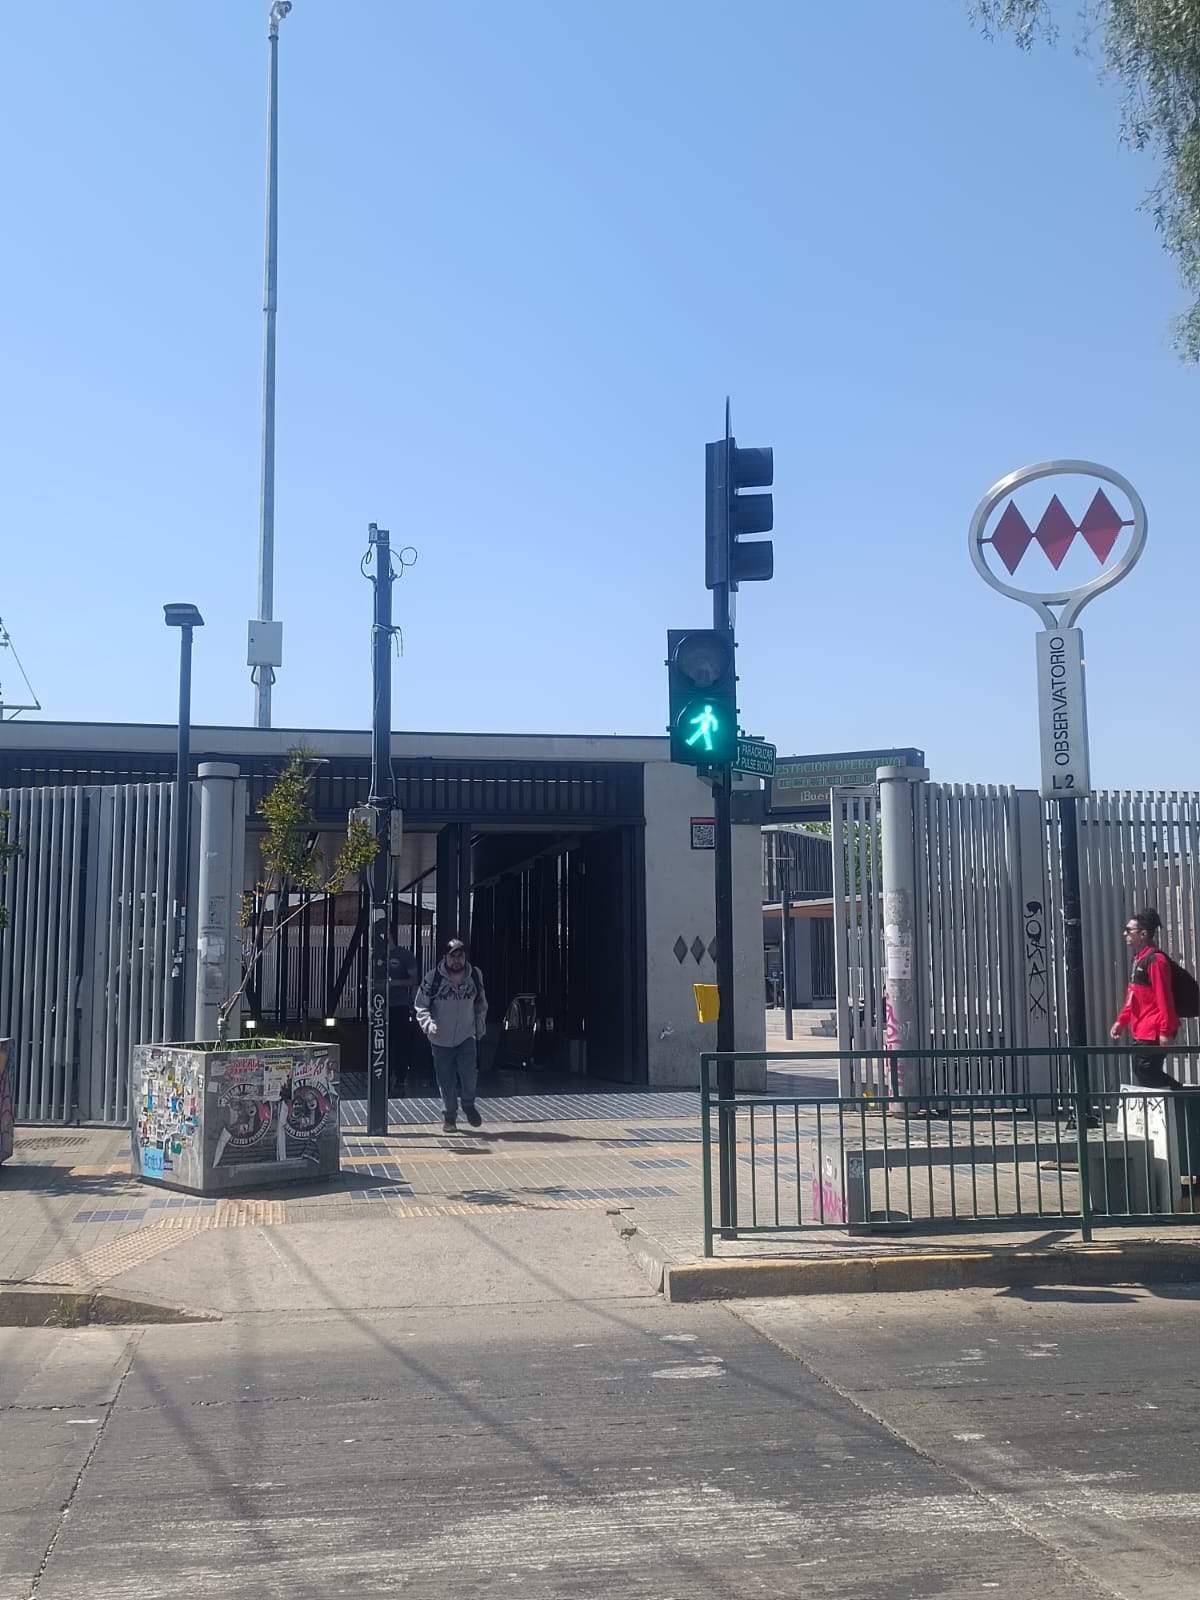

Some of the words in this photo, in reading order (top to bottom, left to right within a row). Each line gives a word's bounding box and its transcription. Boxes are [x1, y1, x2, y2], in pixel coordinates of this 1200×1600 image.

[1049, 636, 1070, 766] OBSERVATORIO
[741, 757, 756, 770] PULSE
[835, 757, 901, 772] OPERATIVA
